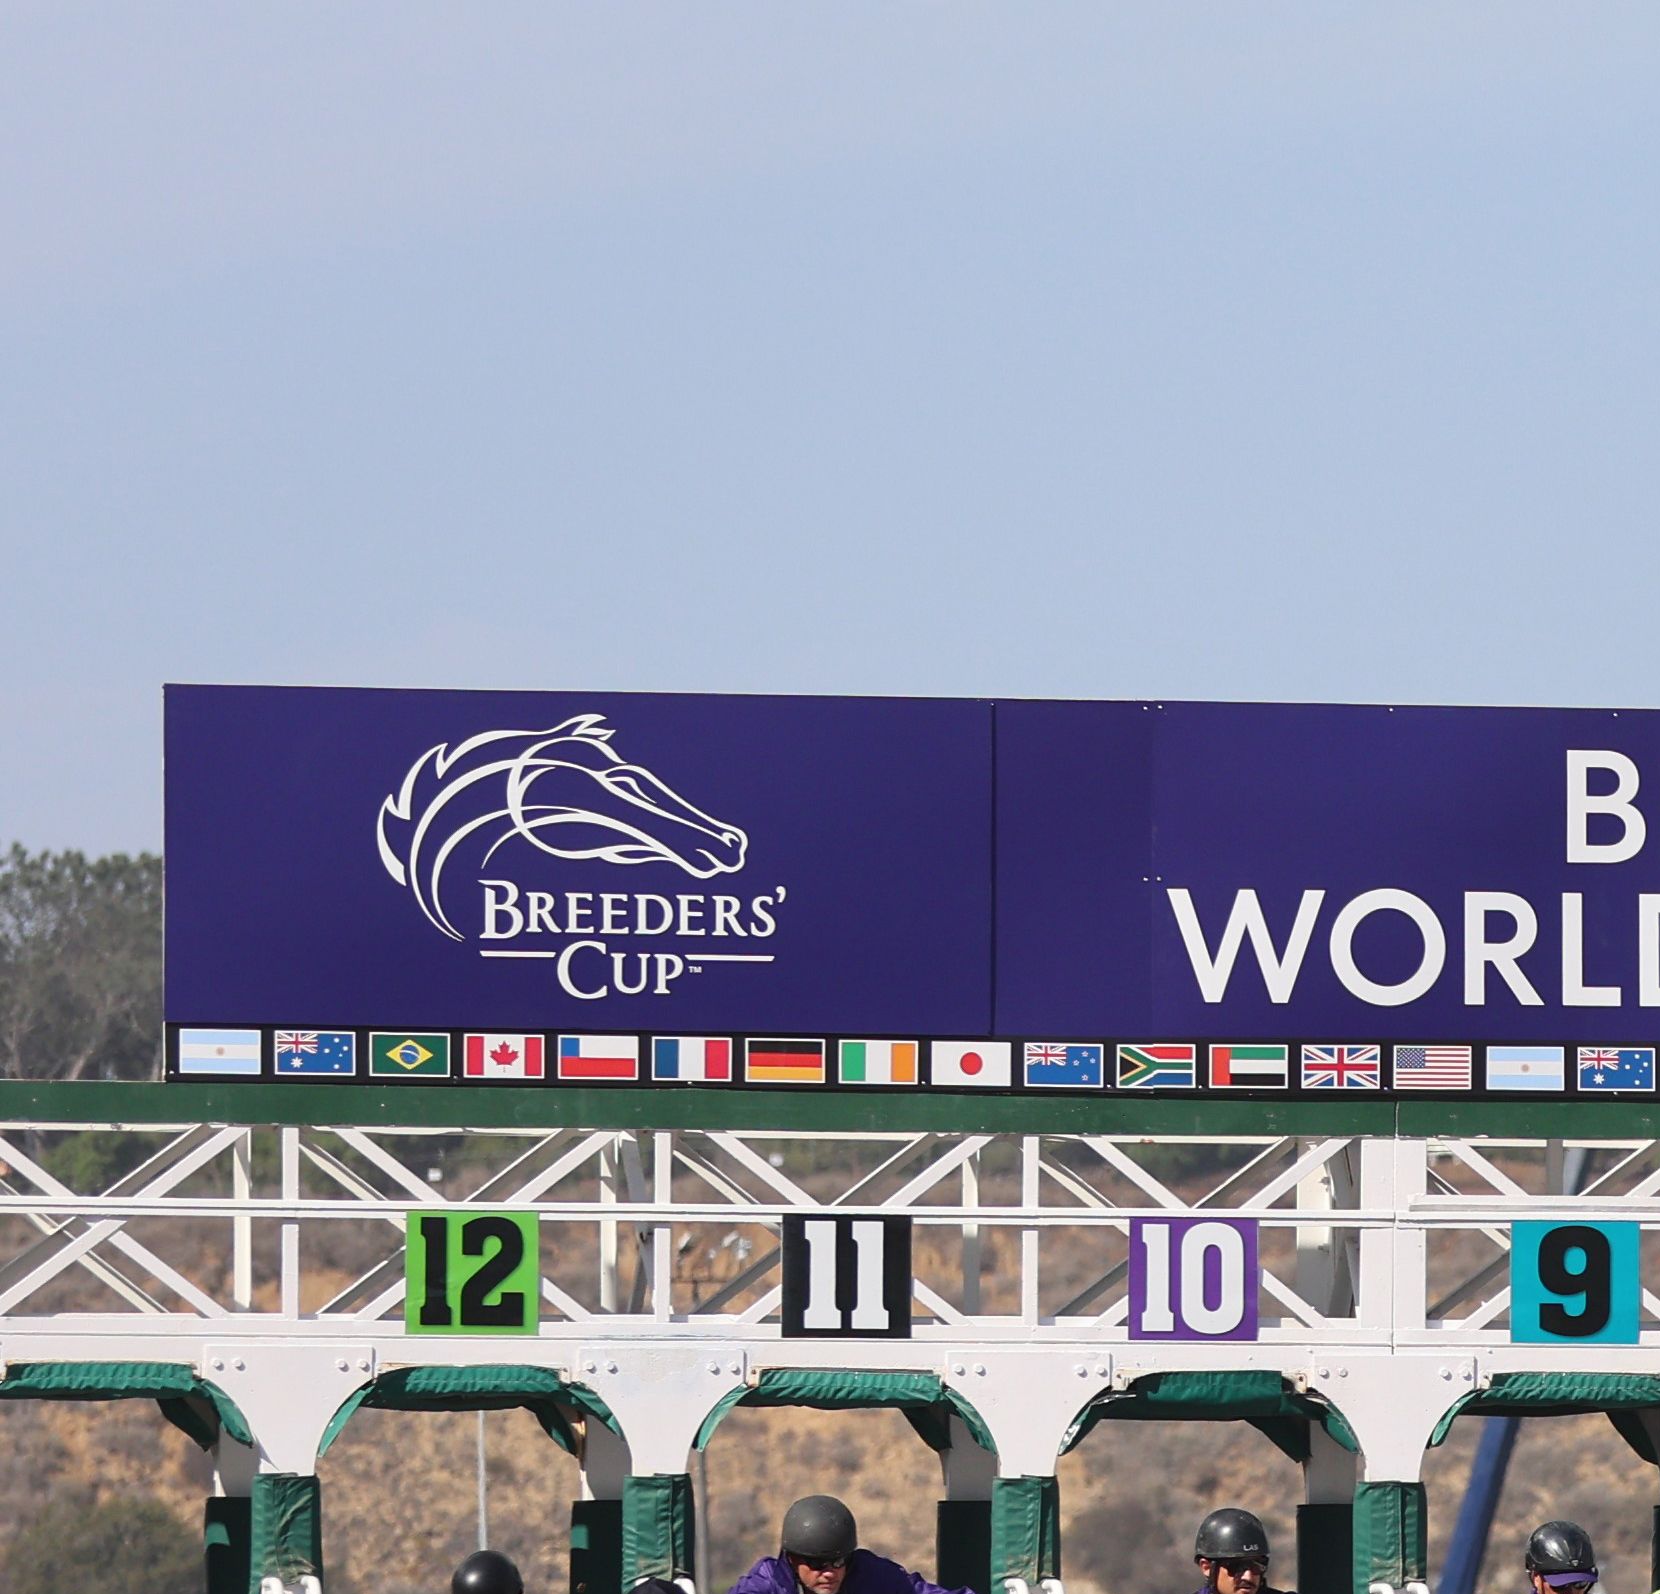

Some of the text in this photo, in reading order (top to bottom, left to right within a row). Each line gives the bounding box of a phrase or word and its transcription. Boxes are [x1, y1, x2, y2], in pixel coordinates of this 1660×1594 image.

[419, 1216, 525, 1327] 12
[803, 1220, 889, 1330] 11
[1141, 1221, 1244, 1335] 10
[1538, 1225, 1611, 1338] 9
